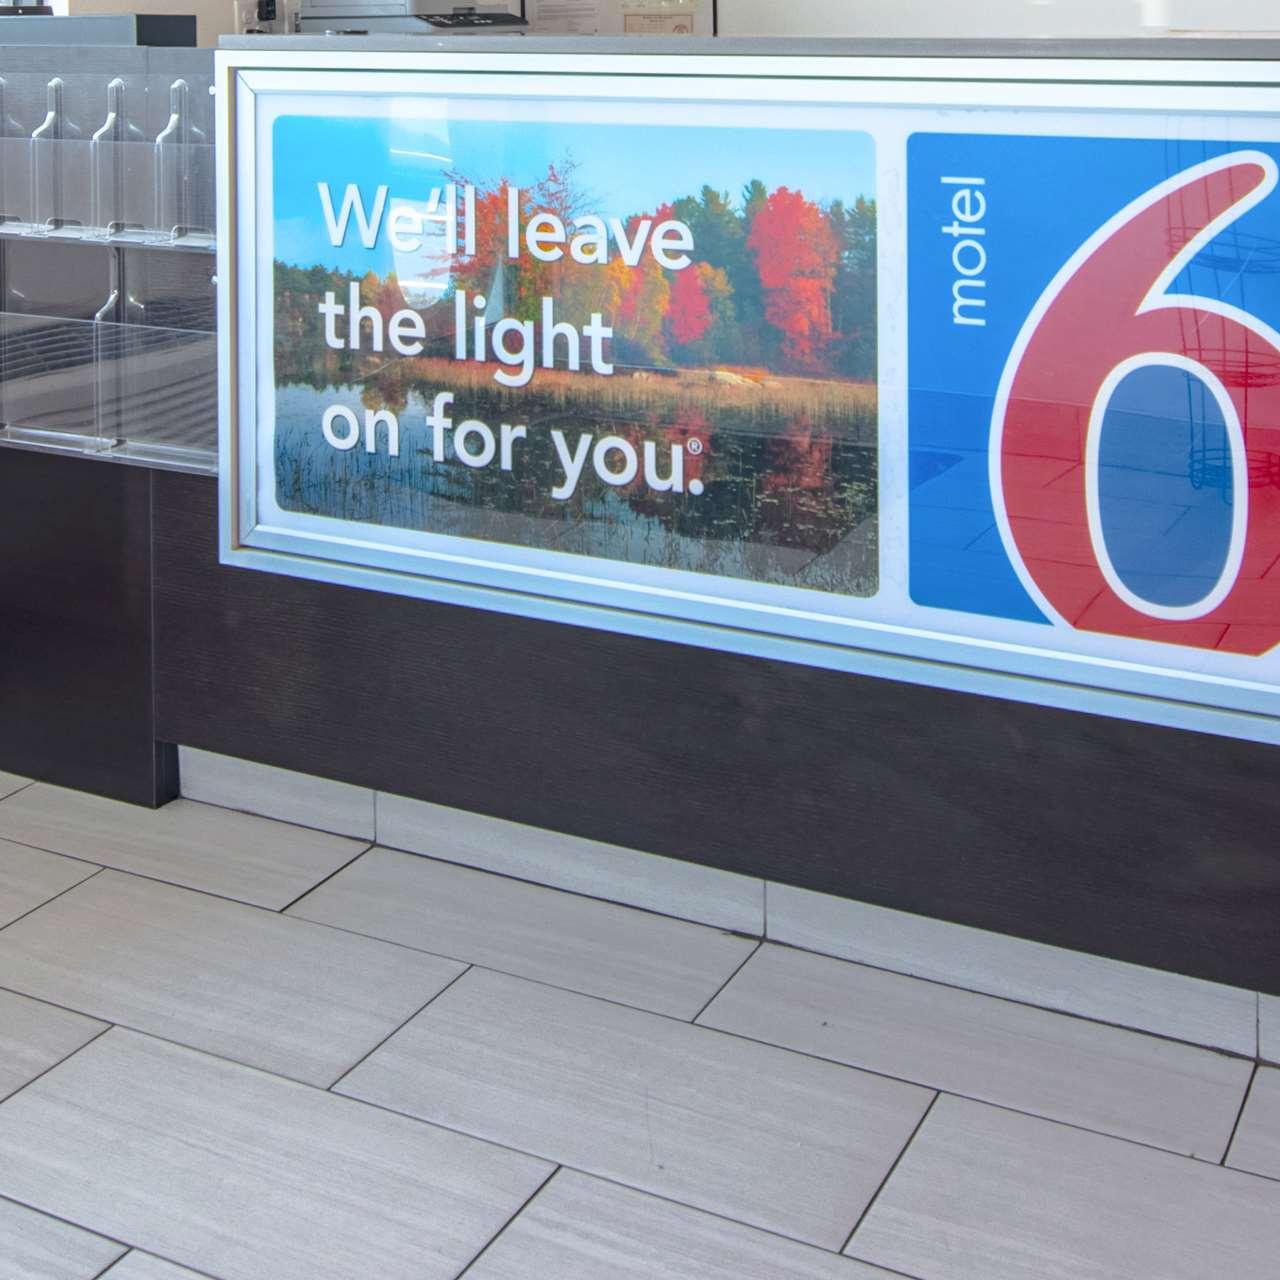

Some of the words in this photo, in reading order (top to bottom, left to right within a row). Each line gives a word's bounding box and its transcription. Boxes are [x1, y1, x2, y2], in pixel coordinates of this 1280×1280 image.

[317, 182, 476, 256] We'll
[507, 187, 695, 271] leave
[940, 176, 986, 327] motel
[317, 281, 427, 357] the
[453, 289, 615, 388] light
[321, 403, 400, 457] on
[425, 391, 527, 472] for
